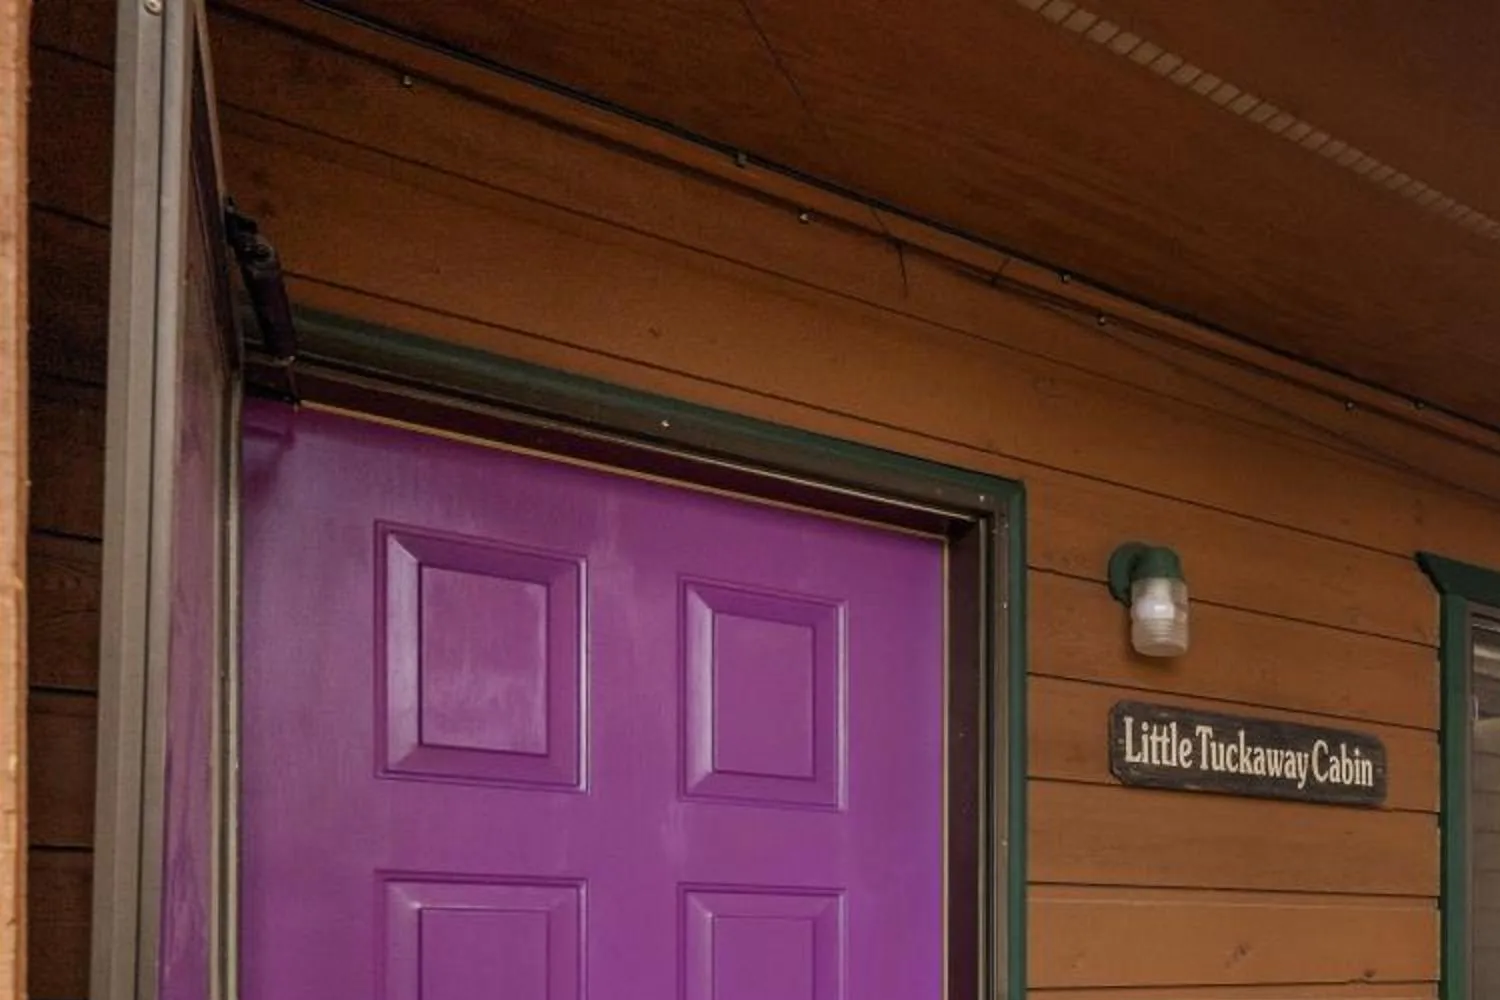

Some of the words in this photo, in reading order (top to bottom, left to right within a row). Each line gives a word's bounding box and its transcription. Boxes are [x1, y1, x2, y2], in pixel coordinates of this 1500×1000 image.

[1123, 716, 1193, 768] Little
[1196, 725, 1309, 789] Tuckaway
[1312, 740, 1374, 787] Cabin
